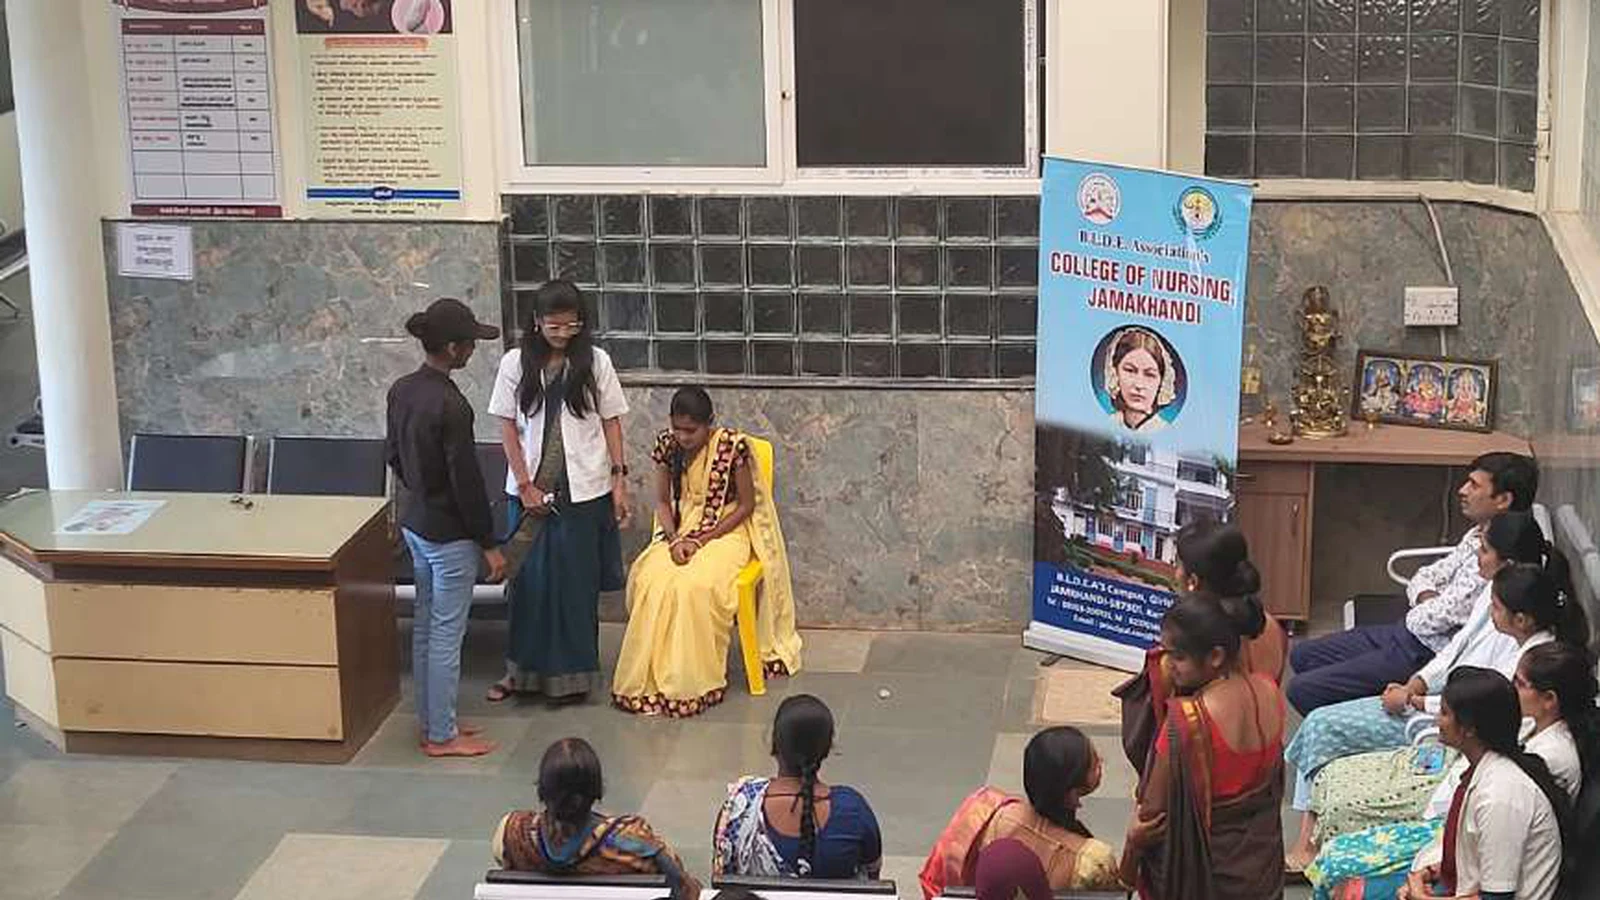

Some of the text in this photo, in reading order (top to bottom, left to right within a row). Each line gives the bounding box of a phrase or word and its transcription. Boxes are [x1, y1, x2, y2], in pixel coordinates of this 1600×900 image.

[1132, 239, 1211, 264] Association's
[1050, 252, 1236, 306] COLLEGE OF NURSING,
[1088, 288, 1202, 324] JAMAKHANDI
